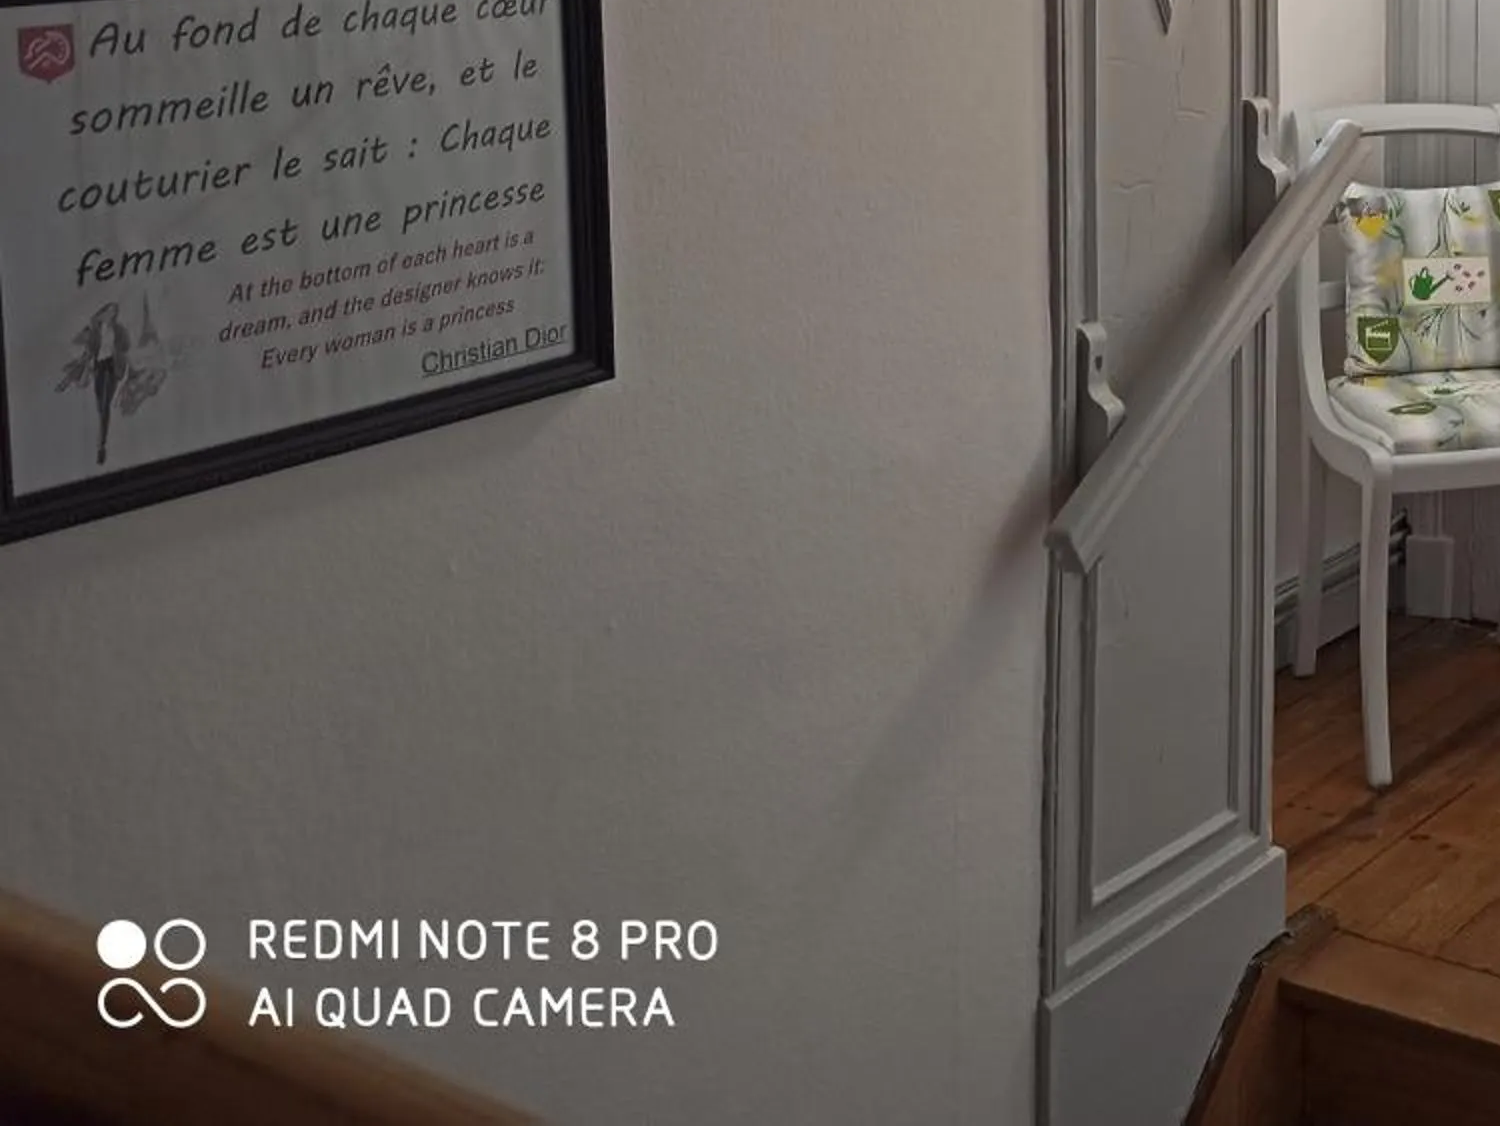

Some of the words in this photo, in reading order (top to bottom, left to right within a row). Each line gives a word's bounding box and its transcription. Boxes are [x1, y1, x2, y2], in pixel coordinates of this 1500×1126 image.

[89, 22, 145, 58] Au
[172, 7, 259, 52] fond
[281, 3, 322, 39] de
[69, 79, 269, 136] sommeille
[291, 80, 335, 108] un
[356, 63, 436, 101] rêve,
[459, 58, 495, 87] et
[513, 48, 538, 81] le
[57, 159, 251, 213] couturier
[272, 145, 302, 181] le
[323, 136, 388, 172] sait
[440, 118, 551, 153] Chaque
[76, 238, 217, 287] femme
[240, 218, 299, 255] est
[321, 209, 382, 242] une
[401, 182, 545, 235] princesse
[228, 281, 254, 305] At
[260, 275, 294, 299] the
[299, 262, 372, 291] bottom
[377, 251, 399, 275] of
[401, 244, 447, 271] each
[452, 233, 500, 260] heart
[504, 230, 520, 250] is
[523, 230, 535, 246] a
[218, 314, 293, 344] dream,
[297, 299, 339, 326] and
[343, 294, 376, 317] the
[380, 276, 462, 309] designer
[464, 262, 526, 290] knows
[261, 343, 319, 371] Every
[324, 324, 396, 356] woman
[401, 319, 417, 338] is
[422, 316, 436, 333] a
[438, 298, 516, 334] princess
[421, 335, 518, 376] Christian
[524, 323, 568, 349] Dior
